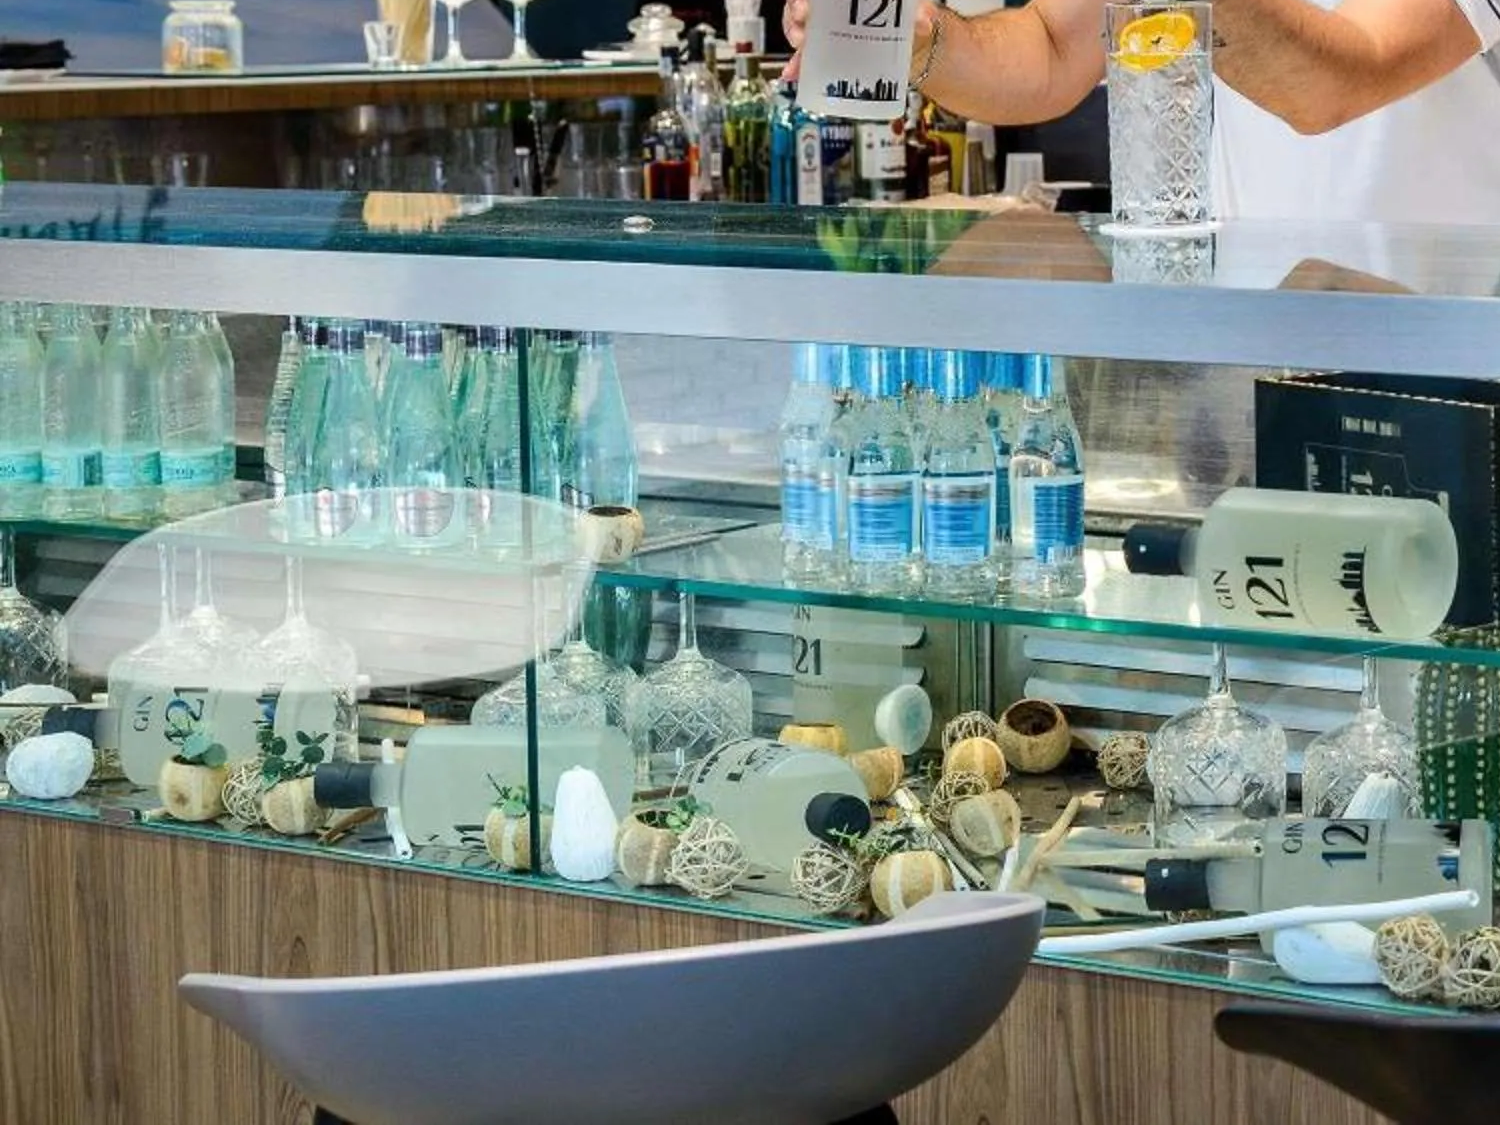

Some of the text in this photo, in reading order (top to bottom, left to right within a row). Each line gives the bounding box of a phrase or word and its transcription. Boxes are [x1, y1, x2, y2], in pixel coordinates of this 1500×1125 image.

[1211, 568, 1236, 611] GIN
[1245, 555, 1295, 619] 121
[793, 634, 822, 676] 21
[132, 695, 154, 733] GIN
[1280, 821, 1304, 855] GIN
[1321, 818, 1370, 869] 12
